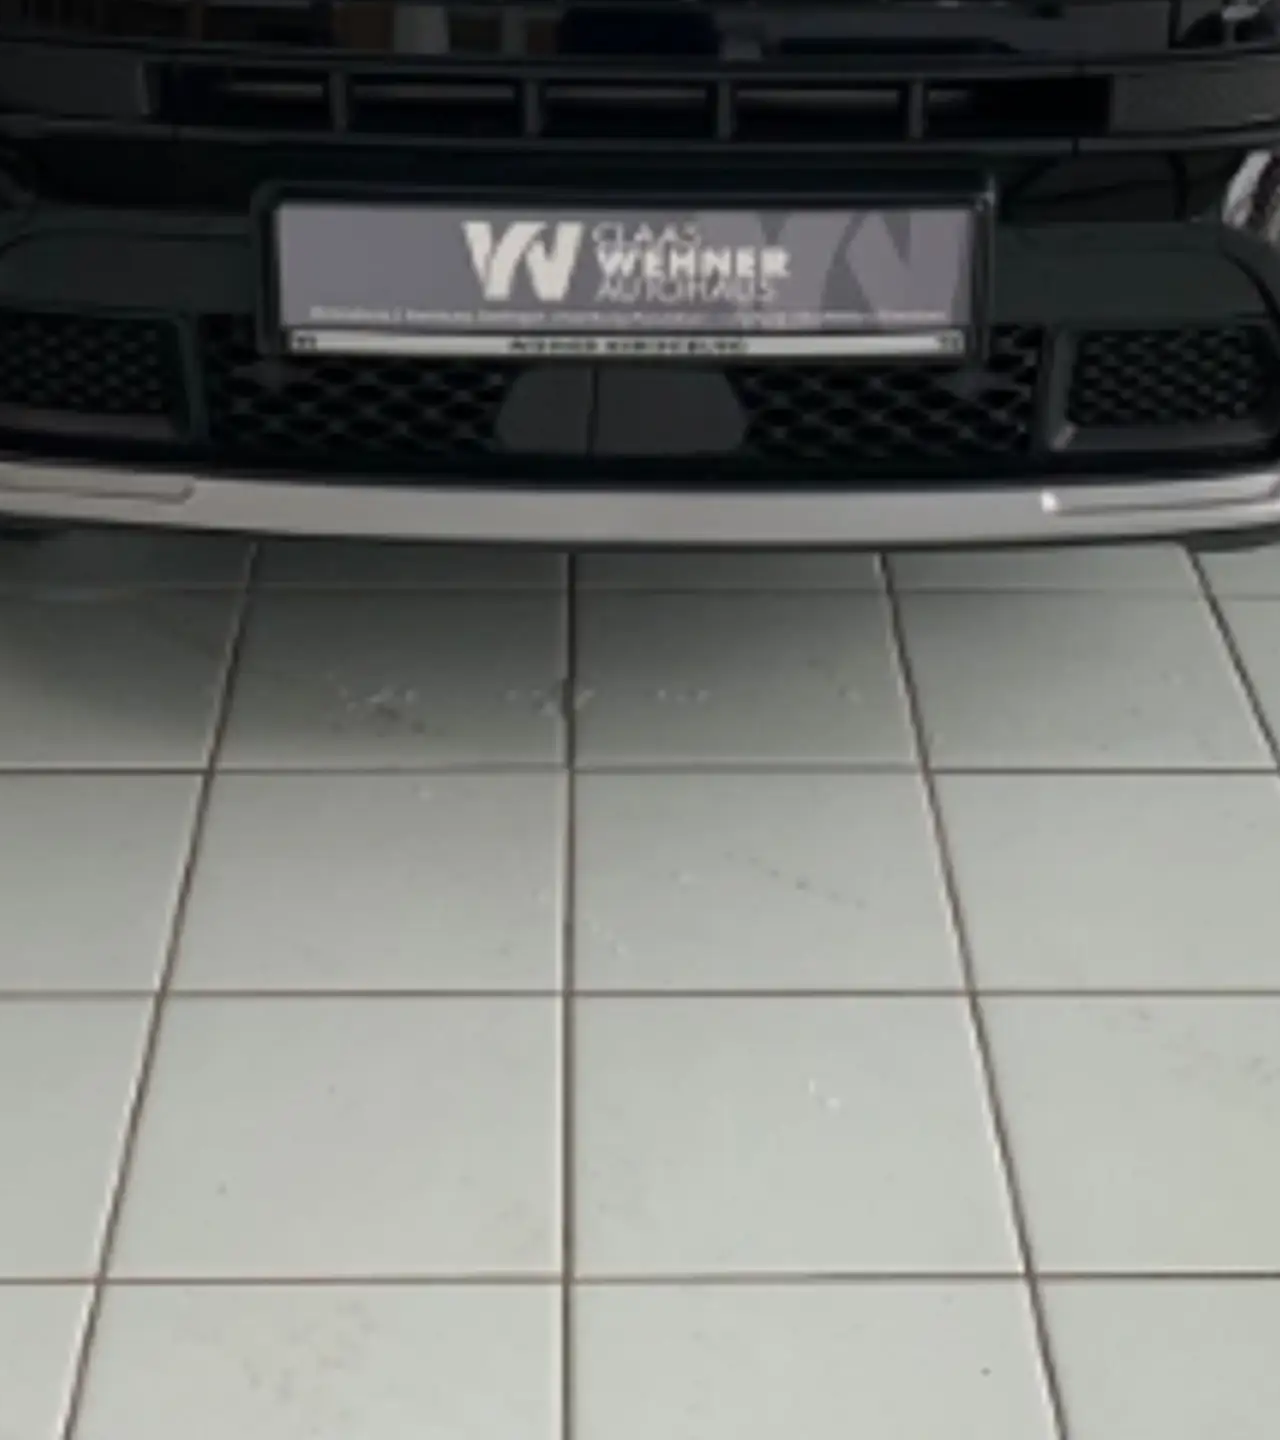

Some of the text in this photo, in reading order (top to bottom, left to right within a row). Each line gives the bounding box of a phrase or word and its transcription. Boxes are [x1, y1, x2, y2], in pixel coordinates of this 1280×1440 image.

[591, 221, 702, 245] CLAAS
[597, 246, 790, 279] WEHNER
[595, 277, 778, 303] AUTOHAUS
